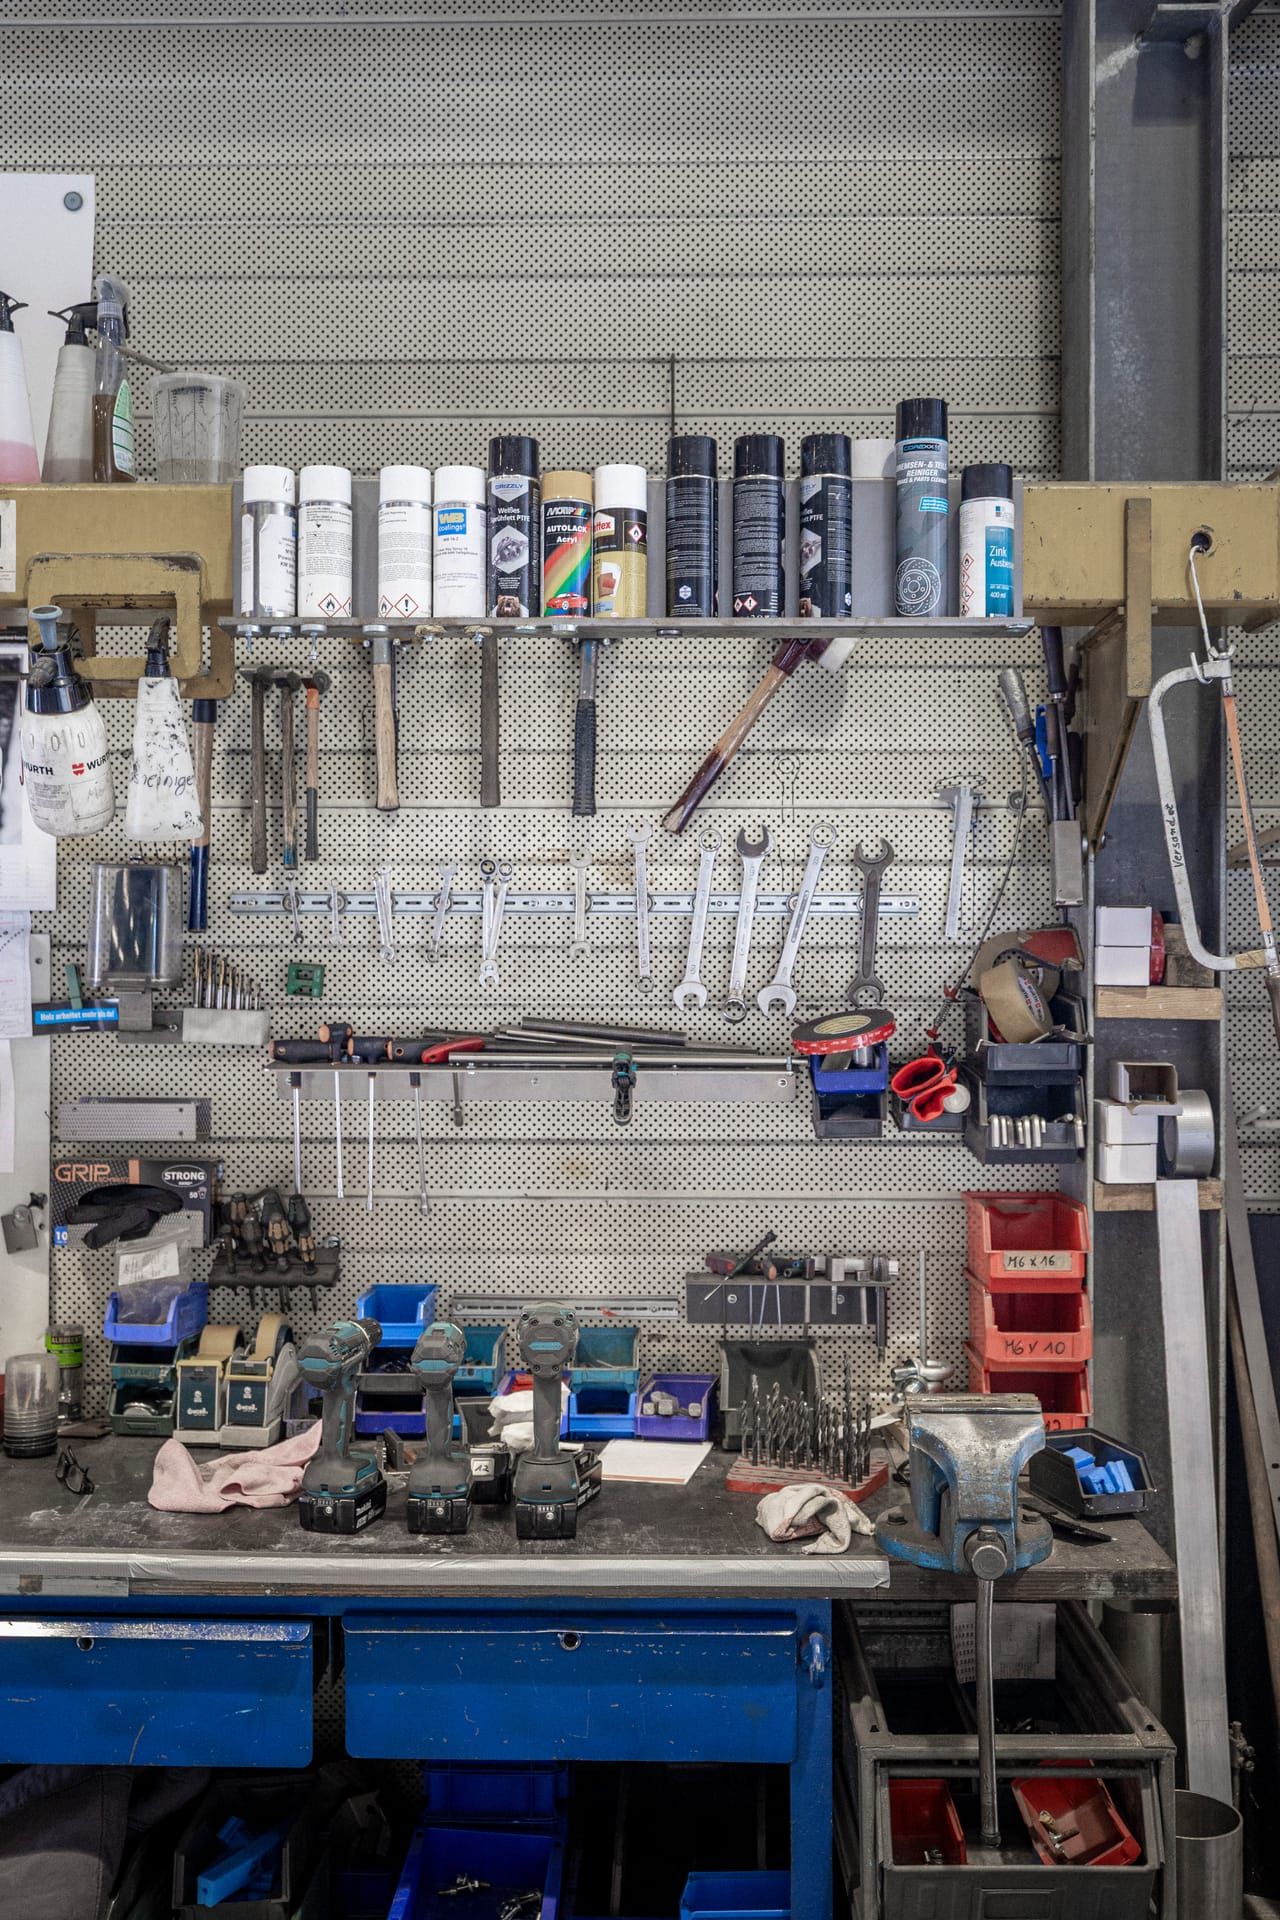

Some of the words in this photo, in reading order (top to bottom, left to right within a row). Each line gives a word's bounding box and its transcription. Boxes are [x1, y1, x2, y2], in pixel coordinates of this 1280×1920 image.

[906, 469, 938, 477] REINIGER
[547, 507, 577, 516] MOTIP
[547, 524, 587, 533] AUTOLACK
[557, 536, 577, 544] Acryl
[990, 545, 1007, 557] Zink
[40, 1013, 54, 1021] Holz
[55, 1012, 80, 1020] arbeitet
[98, 1010, 106, 1018] als
[55, 1164, 110, 1182] GRIP
[164, 1172, 205, 1181] STRONG
[55, 1231, 68, 1241] 10
[1007, 1256, 1025, 1269] M6
[1041, 1254, 1056, 1267] 16
[1005, 1339, 1024, 1355] M6
[1043, 1341, 1066, 1355] 10
[474, 1463, 490, 1474] 12
